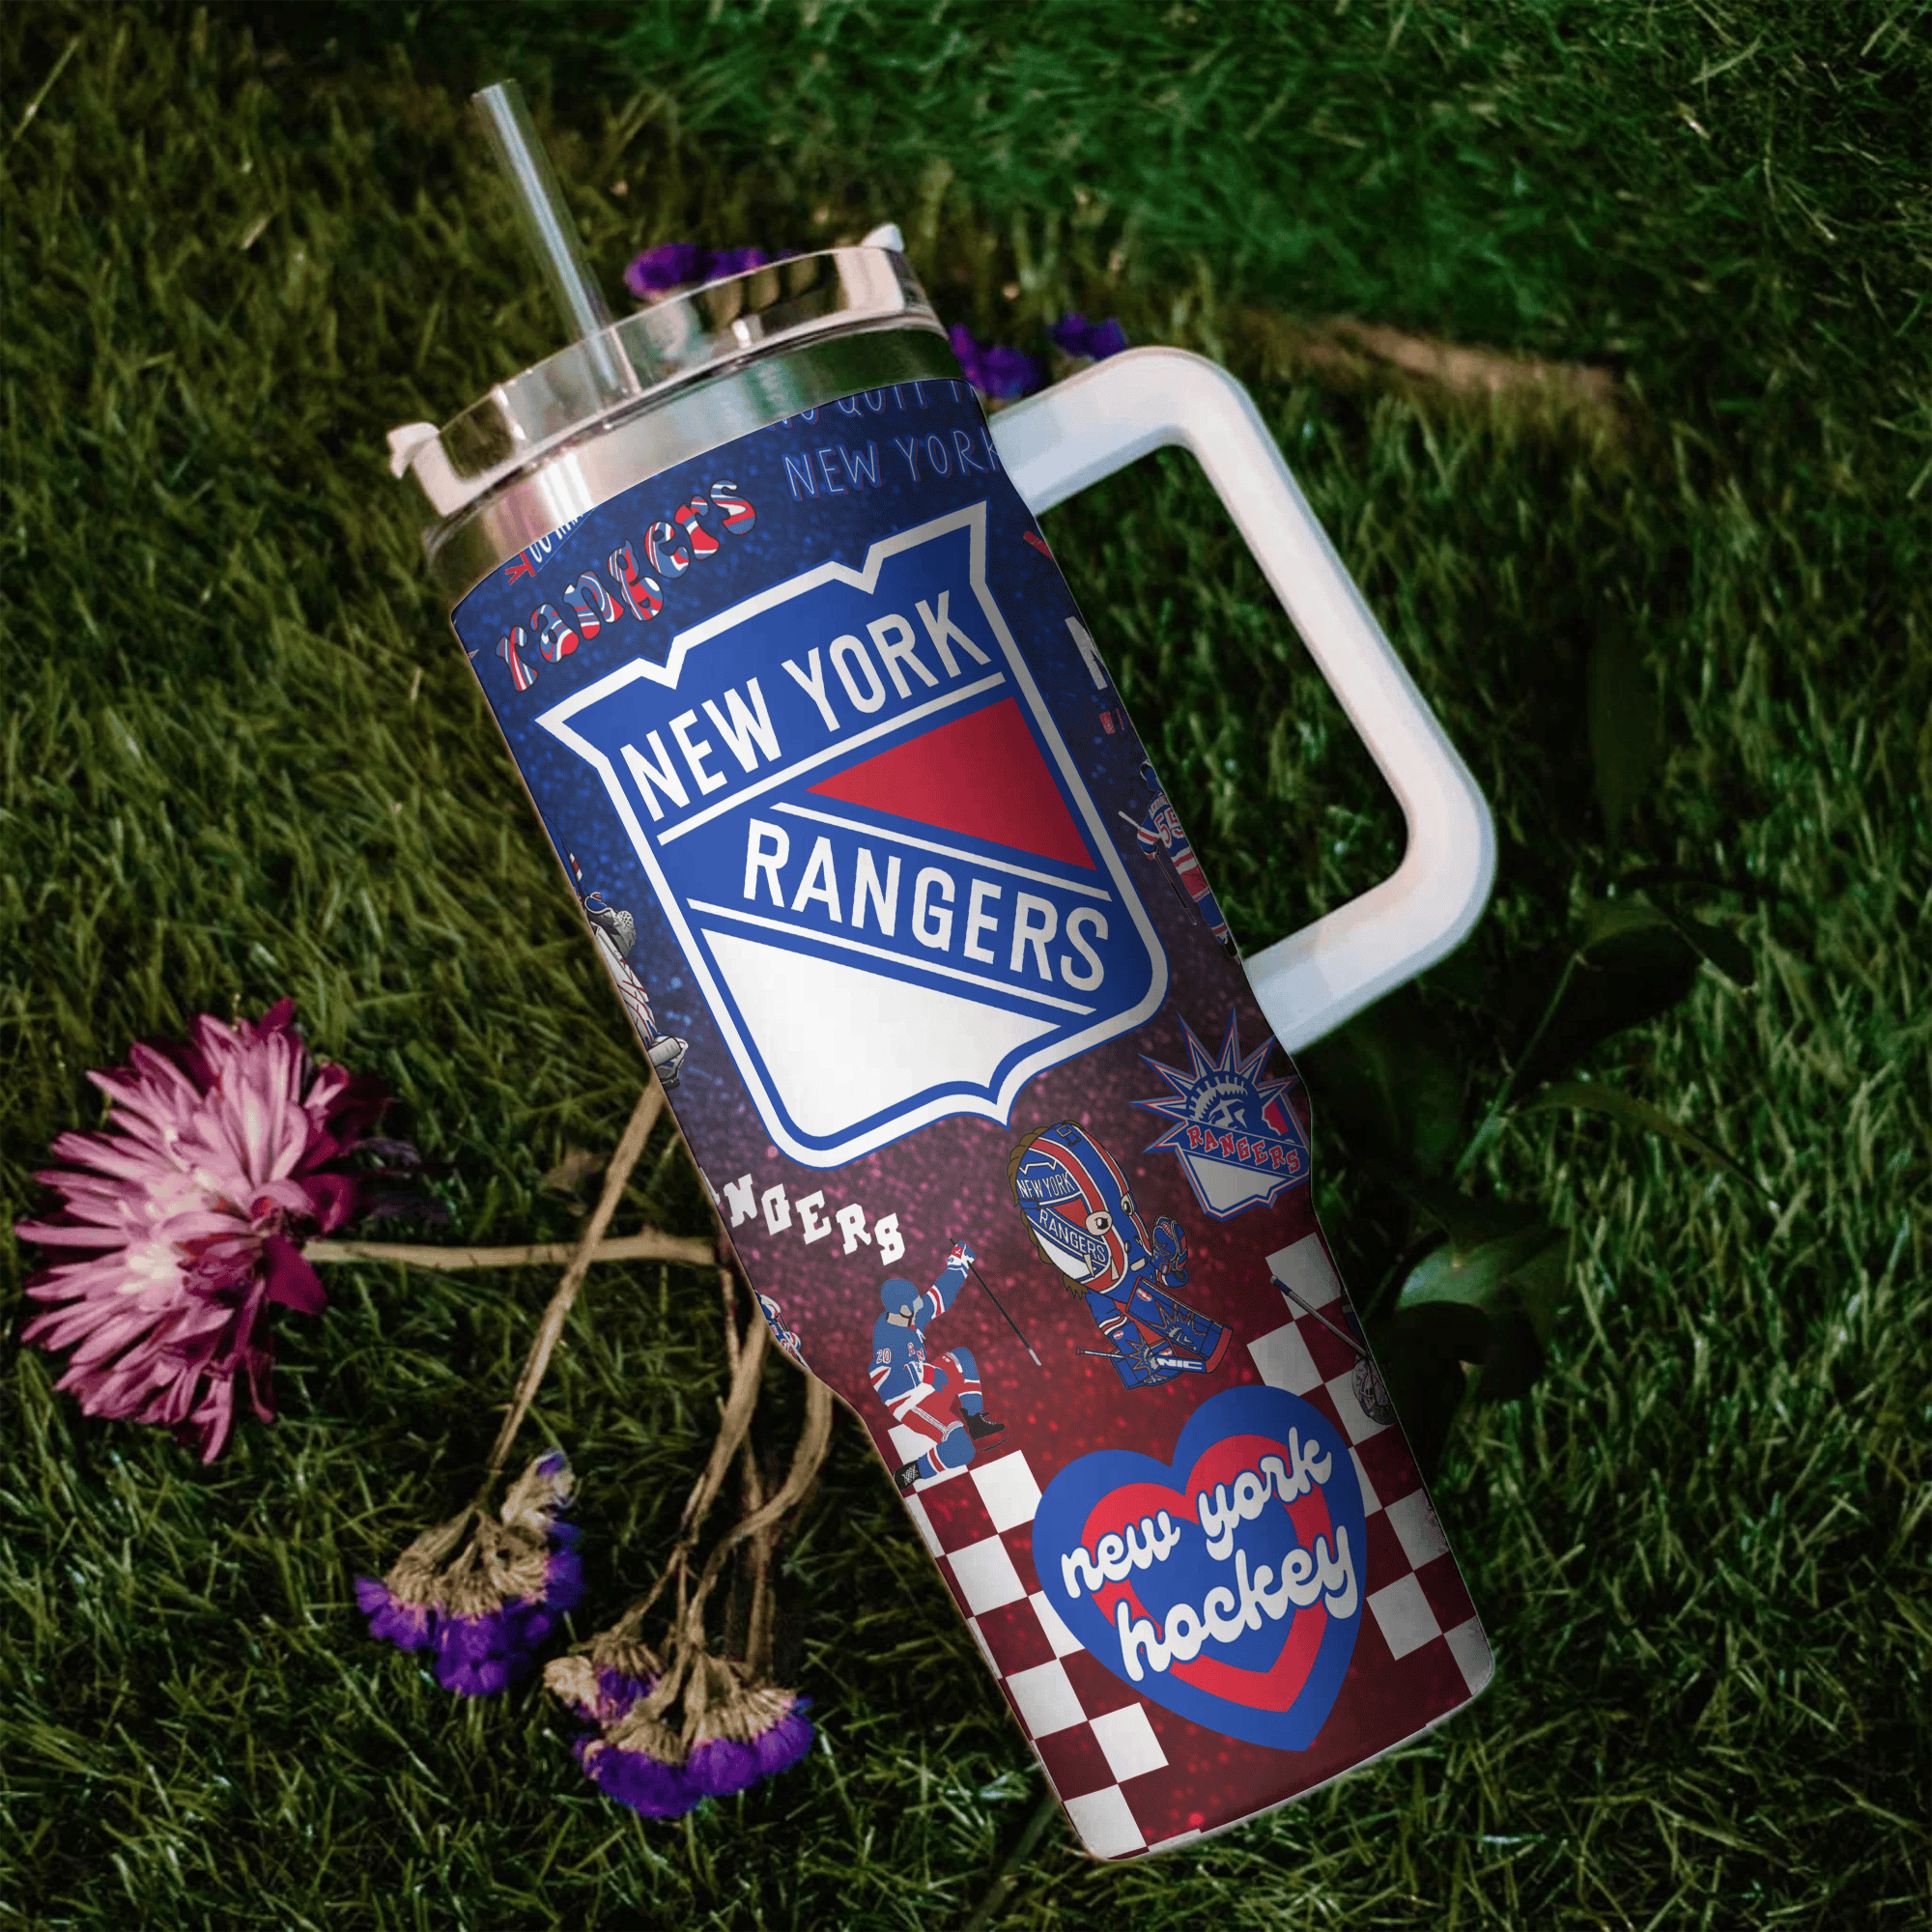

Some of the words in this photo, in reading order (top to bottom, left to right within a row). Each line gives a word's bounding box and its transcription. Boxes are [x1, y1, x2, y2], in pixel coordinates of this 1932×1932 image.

[781, 440, 881, 500] NEW
[495, 479, 756, 693] rangers
[620, 677, 781, 821] NEW
[781, 590, 991, 732] YORK
[743, 817, 1109, 992] RANGERS
[1042, 1172, 1076, 1198] YORK
[1186, 1124, 1300, 1175] RANGERS
[1039, 1208, 1106, 1263] RANGERS
[875, 1348, 892, 1364] 20
[1062, 1510, 1181, 1600] new
[1198, 1426, 1333, 1562] york
[1115, 1524, 1359, 1683] hockey
